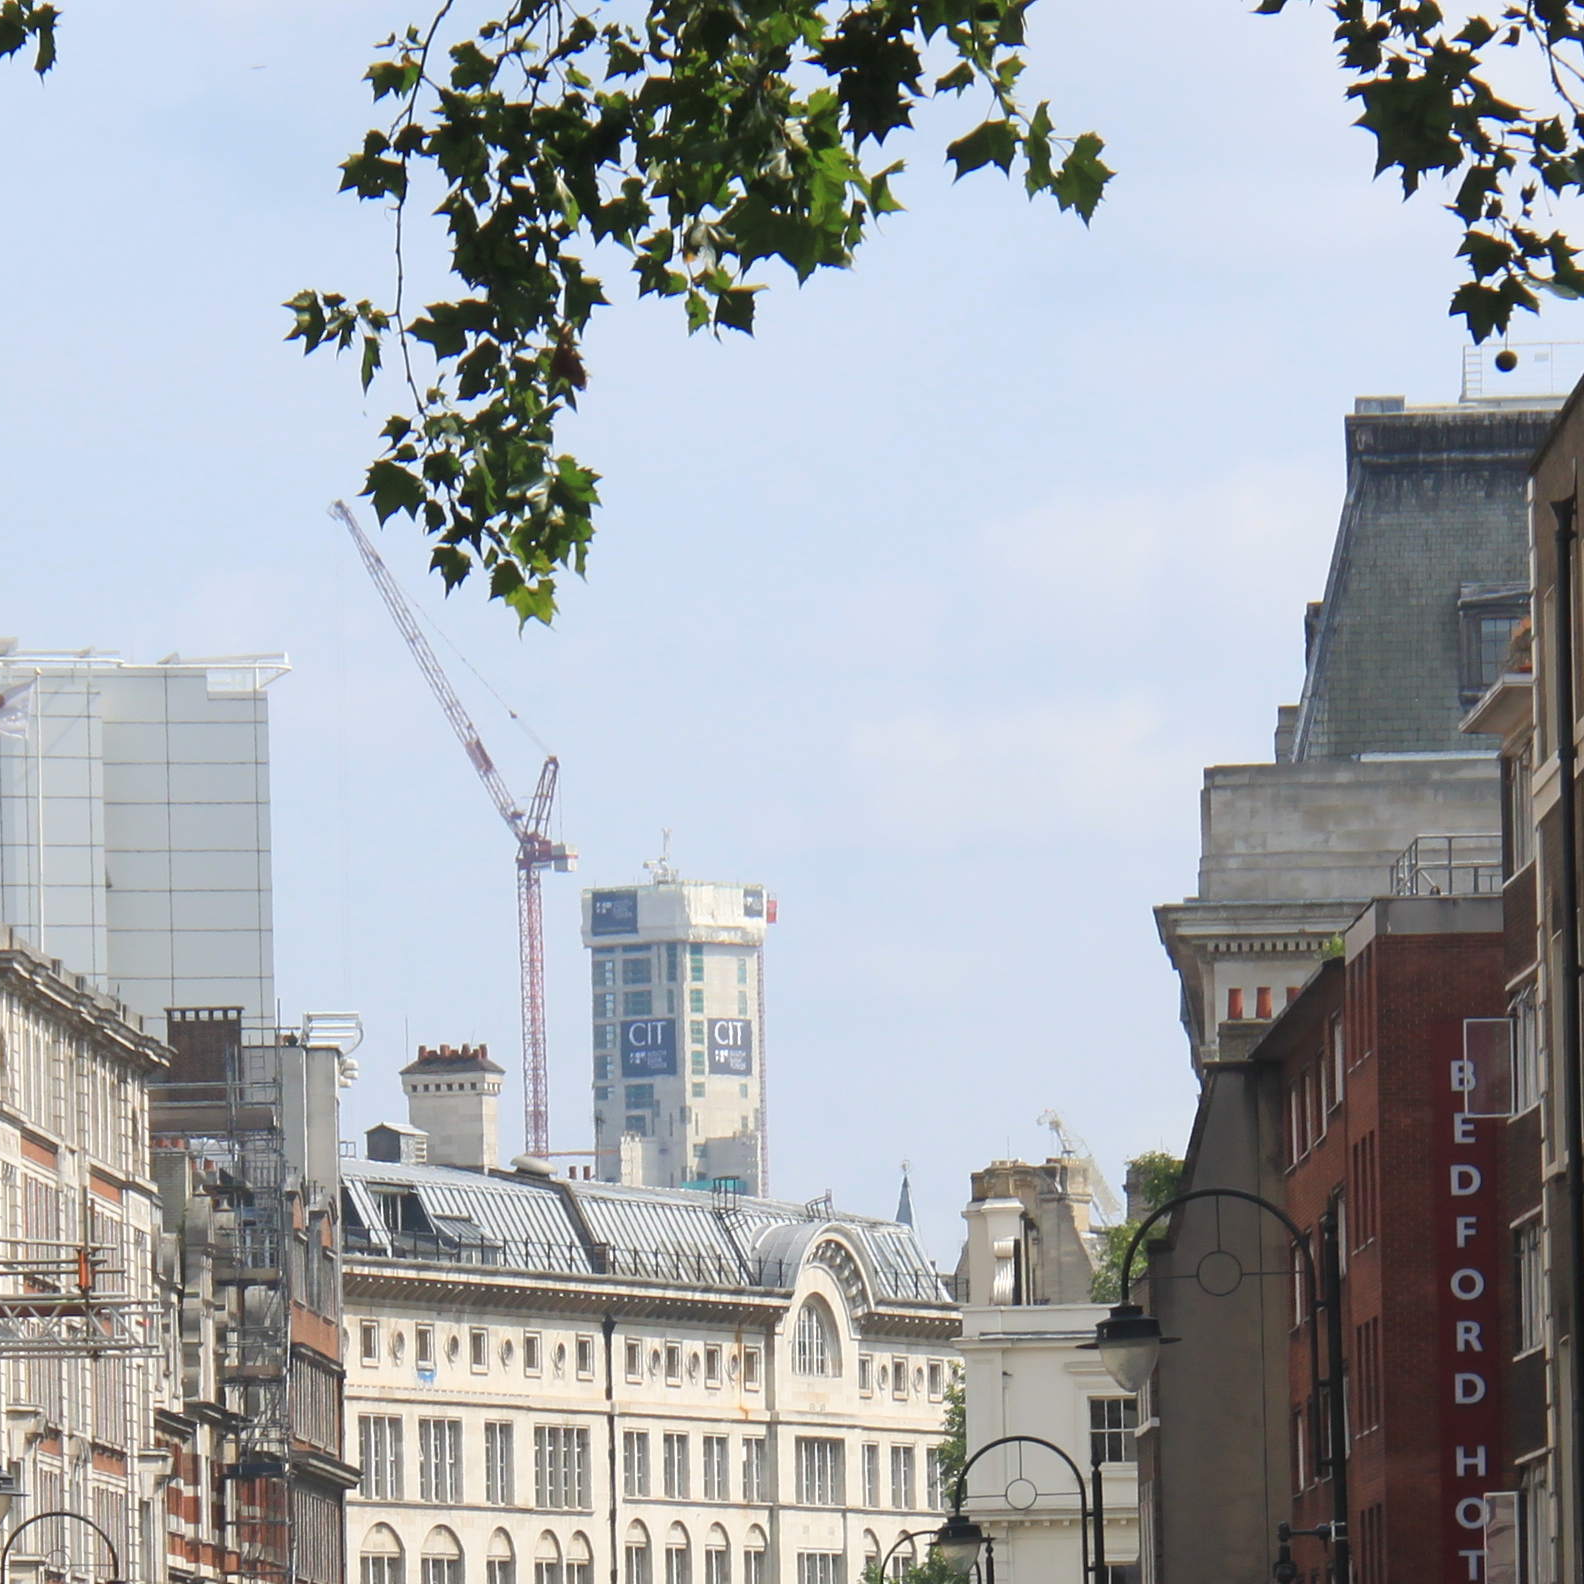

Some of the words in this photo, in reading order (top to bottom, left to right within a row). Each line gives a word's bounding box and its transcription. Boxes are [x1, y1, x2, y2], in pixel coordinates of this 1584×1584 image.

[629, 1021, 667, 1045] CIT
[714, 1021, 745, 1045] CIT
[1449, 1059, 1485, 1405] BEDFORD
